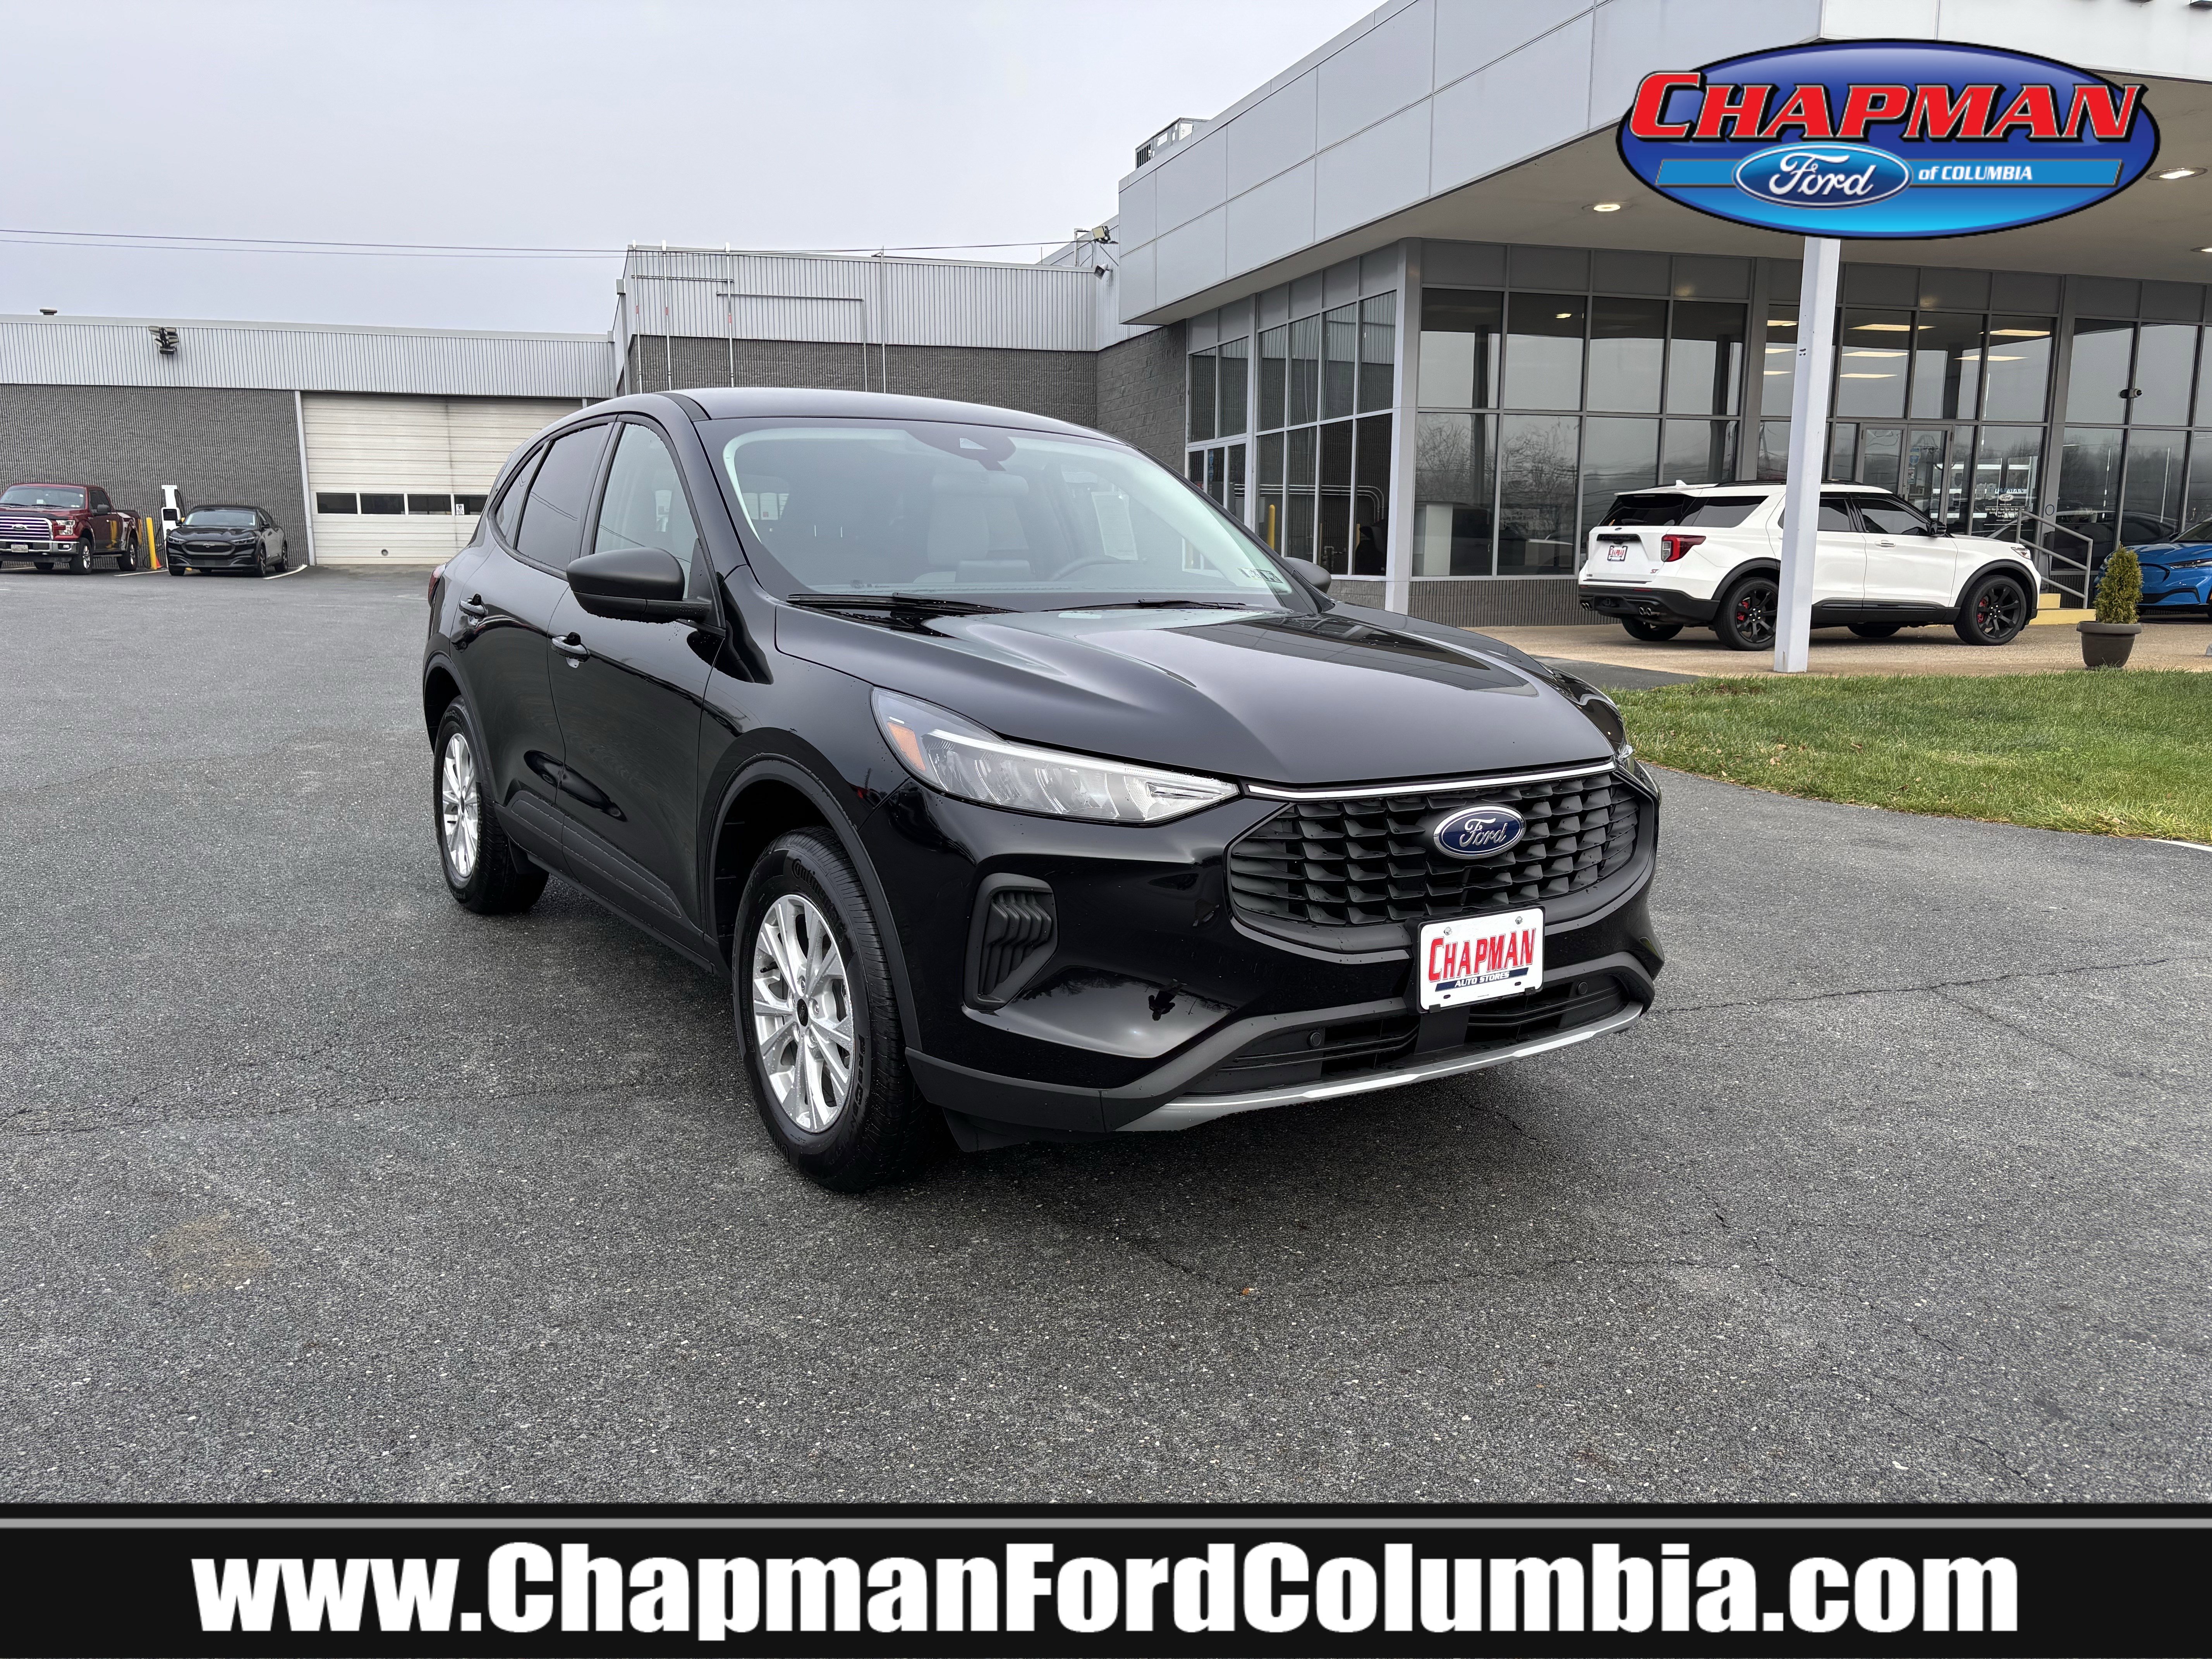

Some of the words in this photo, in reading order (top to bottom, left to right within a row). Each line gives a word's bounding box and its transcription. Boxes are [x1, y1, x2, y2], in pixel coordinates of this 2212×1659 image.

[1460, 817, 1508, 848] Ford
[1427, 928, 1536, 983] CHAPMAN
[1455, 977, 1477, 988] AUTO
[1479, 971, 1510, 983] STORES
